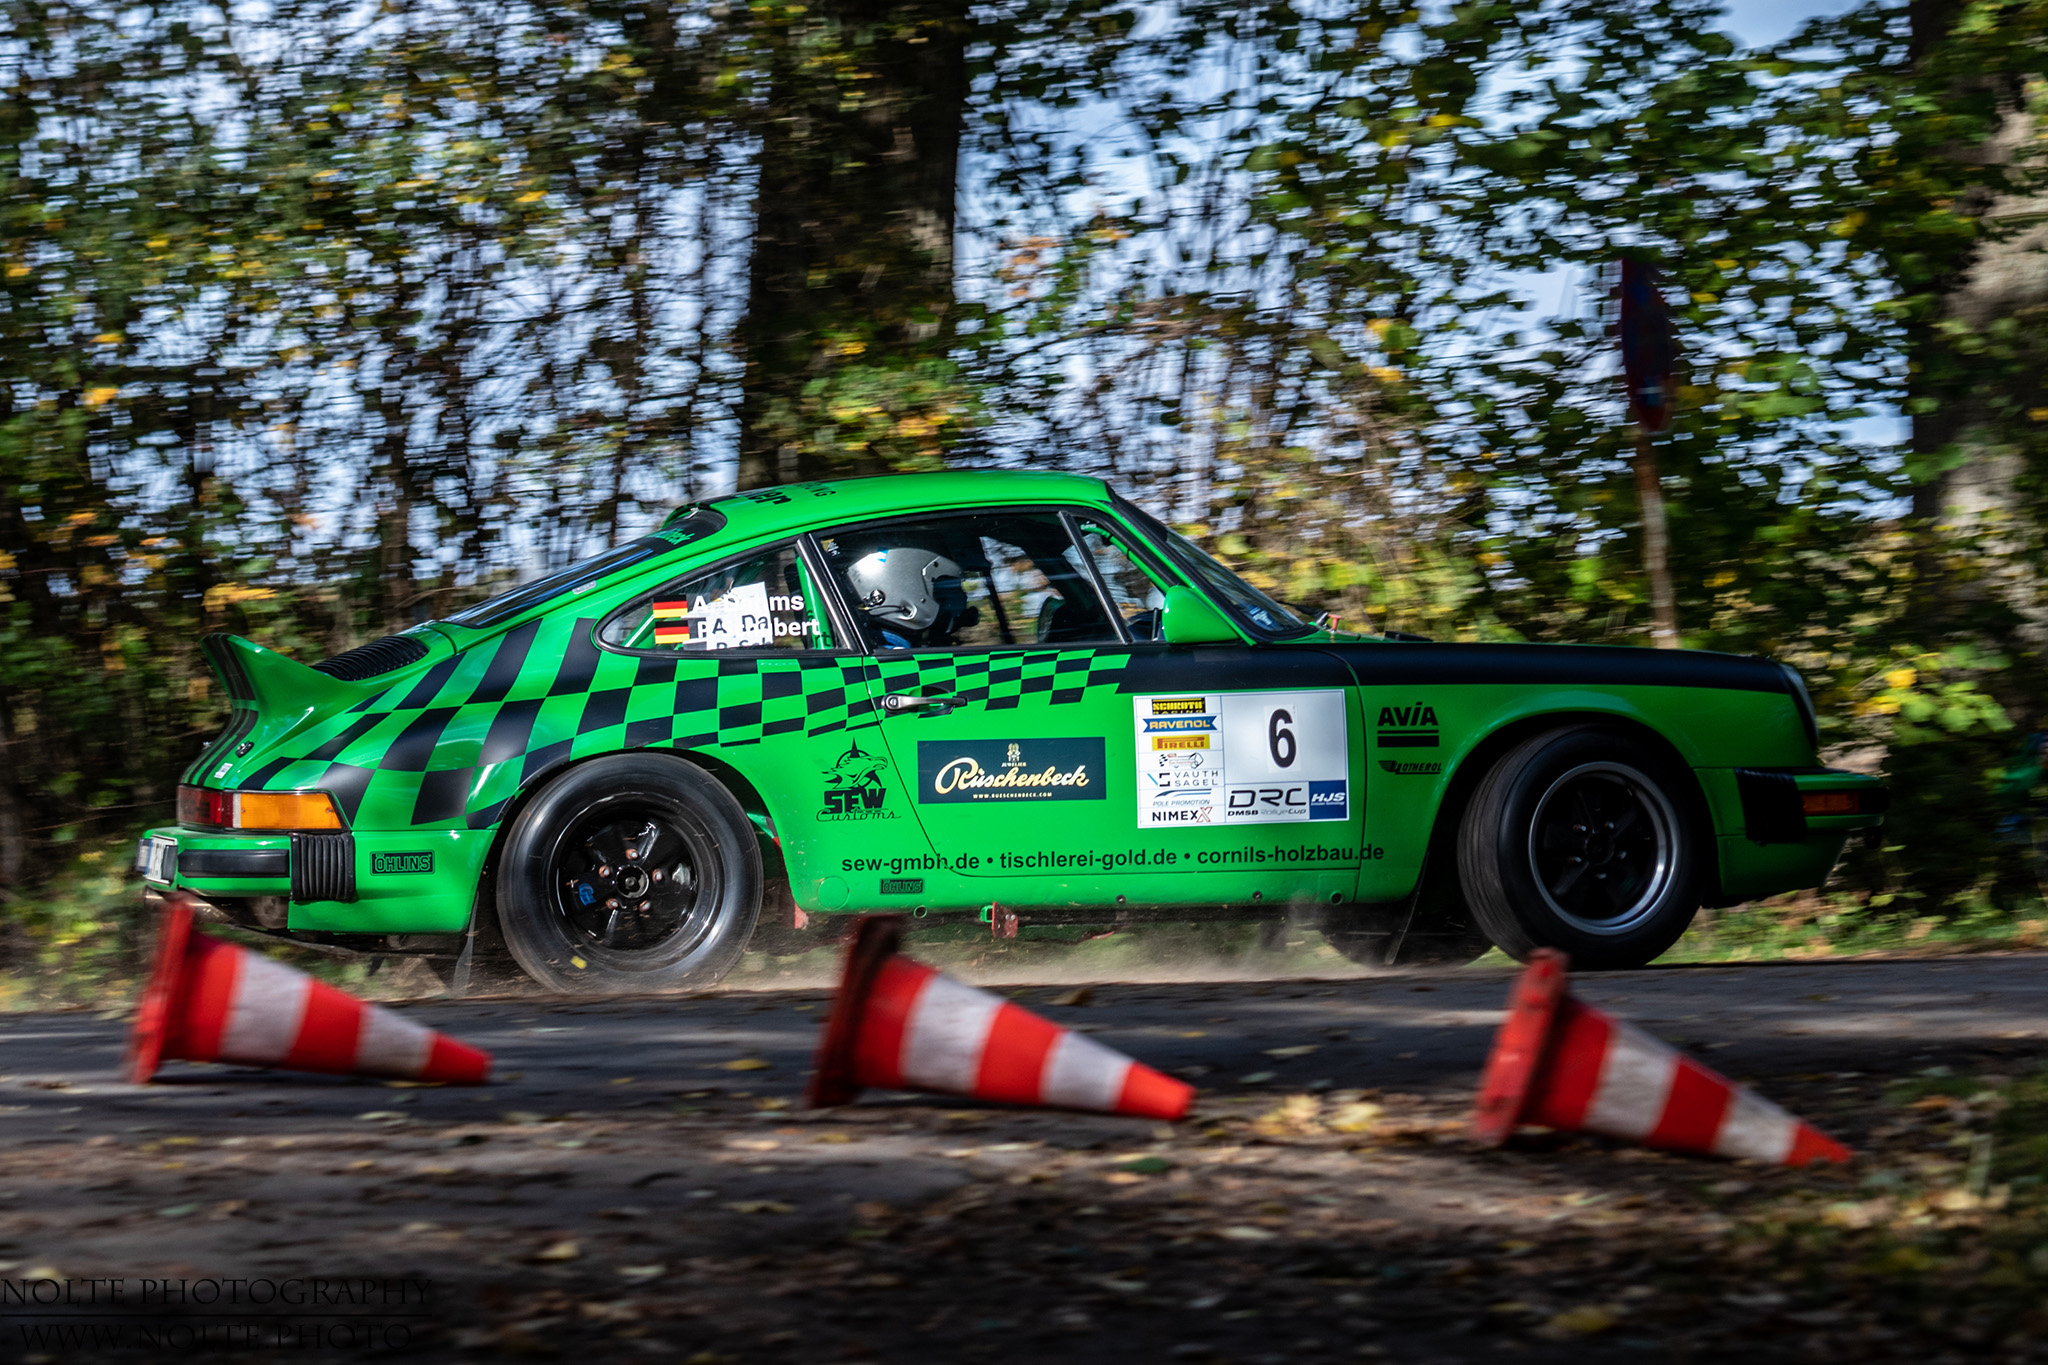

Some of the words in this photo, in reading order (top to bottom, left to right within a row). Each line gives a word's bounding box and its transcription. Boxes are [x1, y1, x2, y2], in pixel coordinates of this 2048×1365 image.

[1149, 720, 1211, 730] RAVENOL
[1157, 736, 1205, 749] PIRELLI
[1268, 708, 1297, 769] 6
[934, 757, 1090, 795] Rüschenbeck
[1174, 770, 1219, 779] VAUTH
[1174, 779, 1219, 788] SAGEL
[824, 787, 887, 814] SEW
[1171, 798, 1211, 806] PROMOTION
[1228, 788, 1307, 808] DRC
[1311, 792, 1346, 802] HJS
[816, 806, 902, 822] Customs
[1227, 809, 1259, 817] DMSB
[375, 853, 432, 872] ÖHLINS
[841, 853, 980, 874] sew-gmbh.de
[1000, 850, 1177, 871] tischlerei-gold.de
[1197, 844, 1385, 864] cornils-holzbau.de
